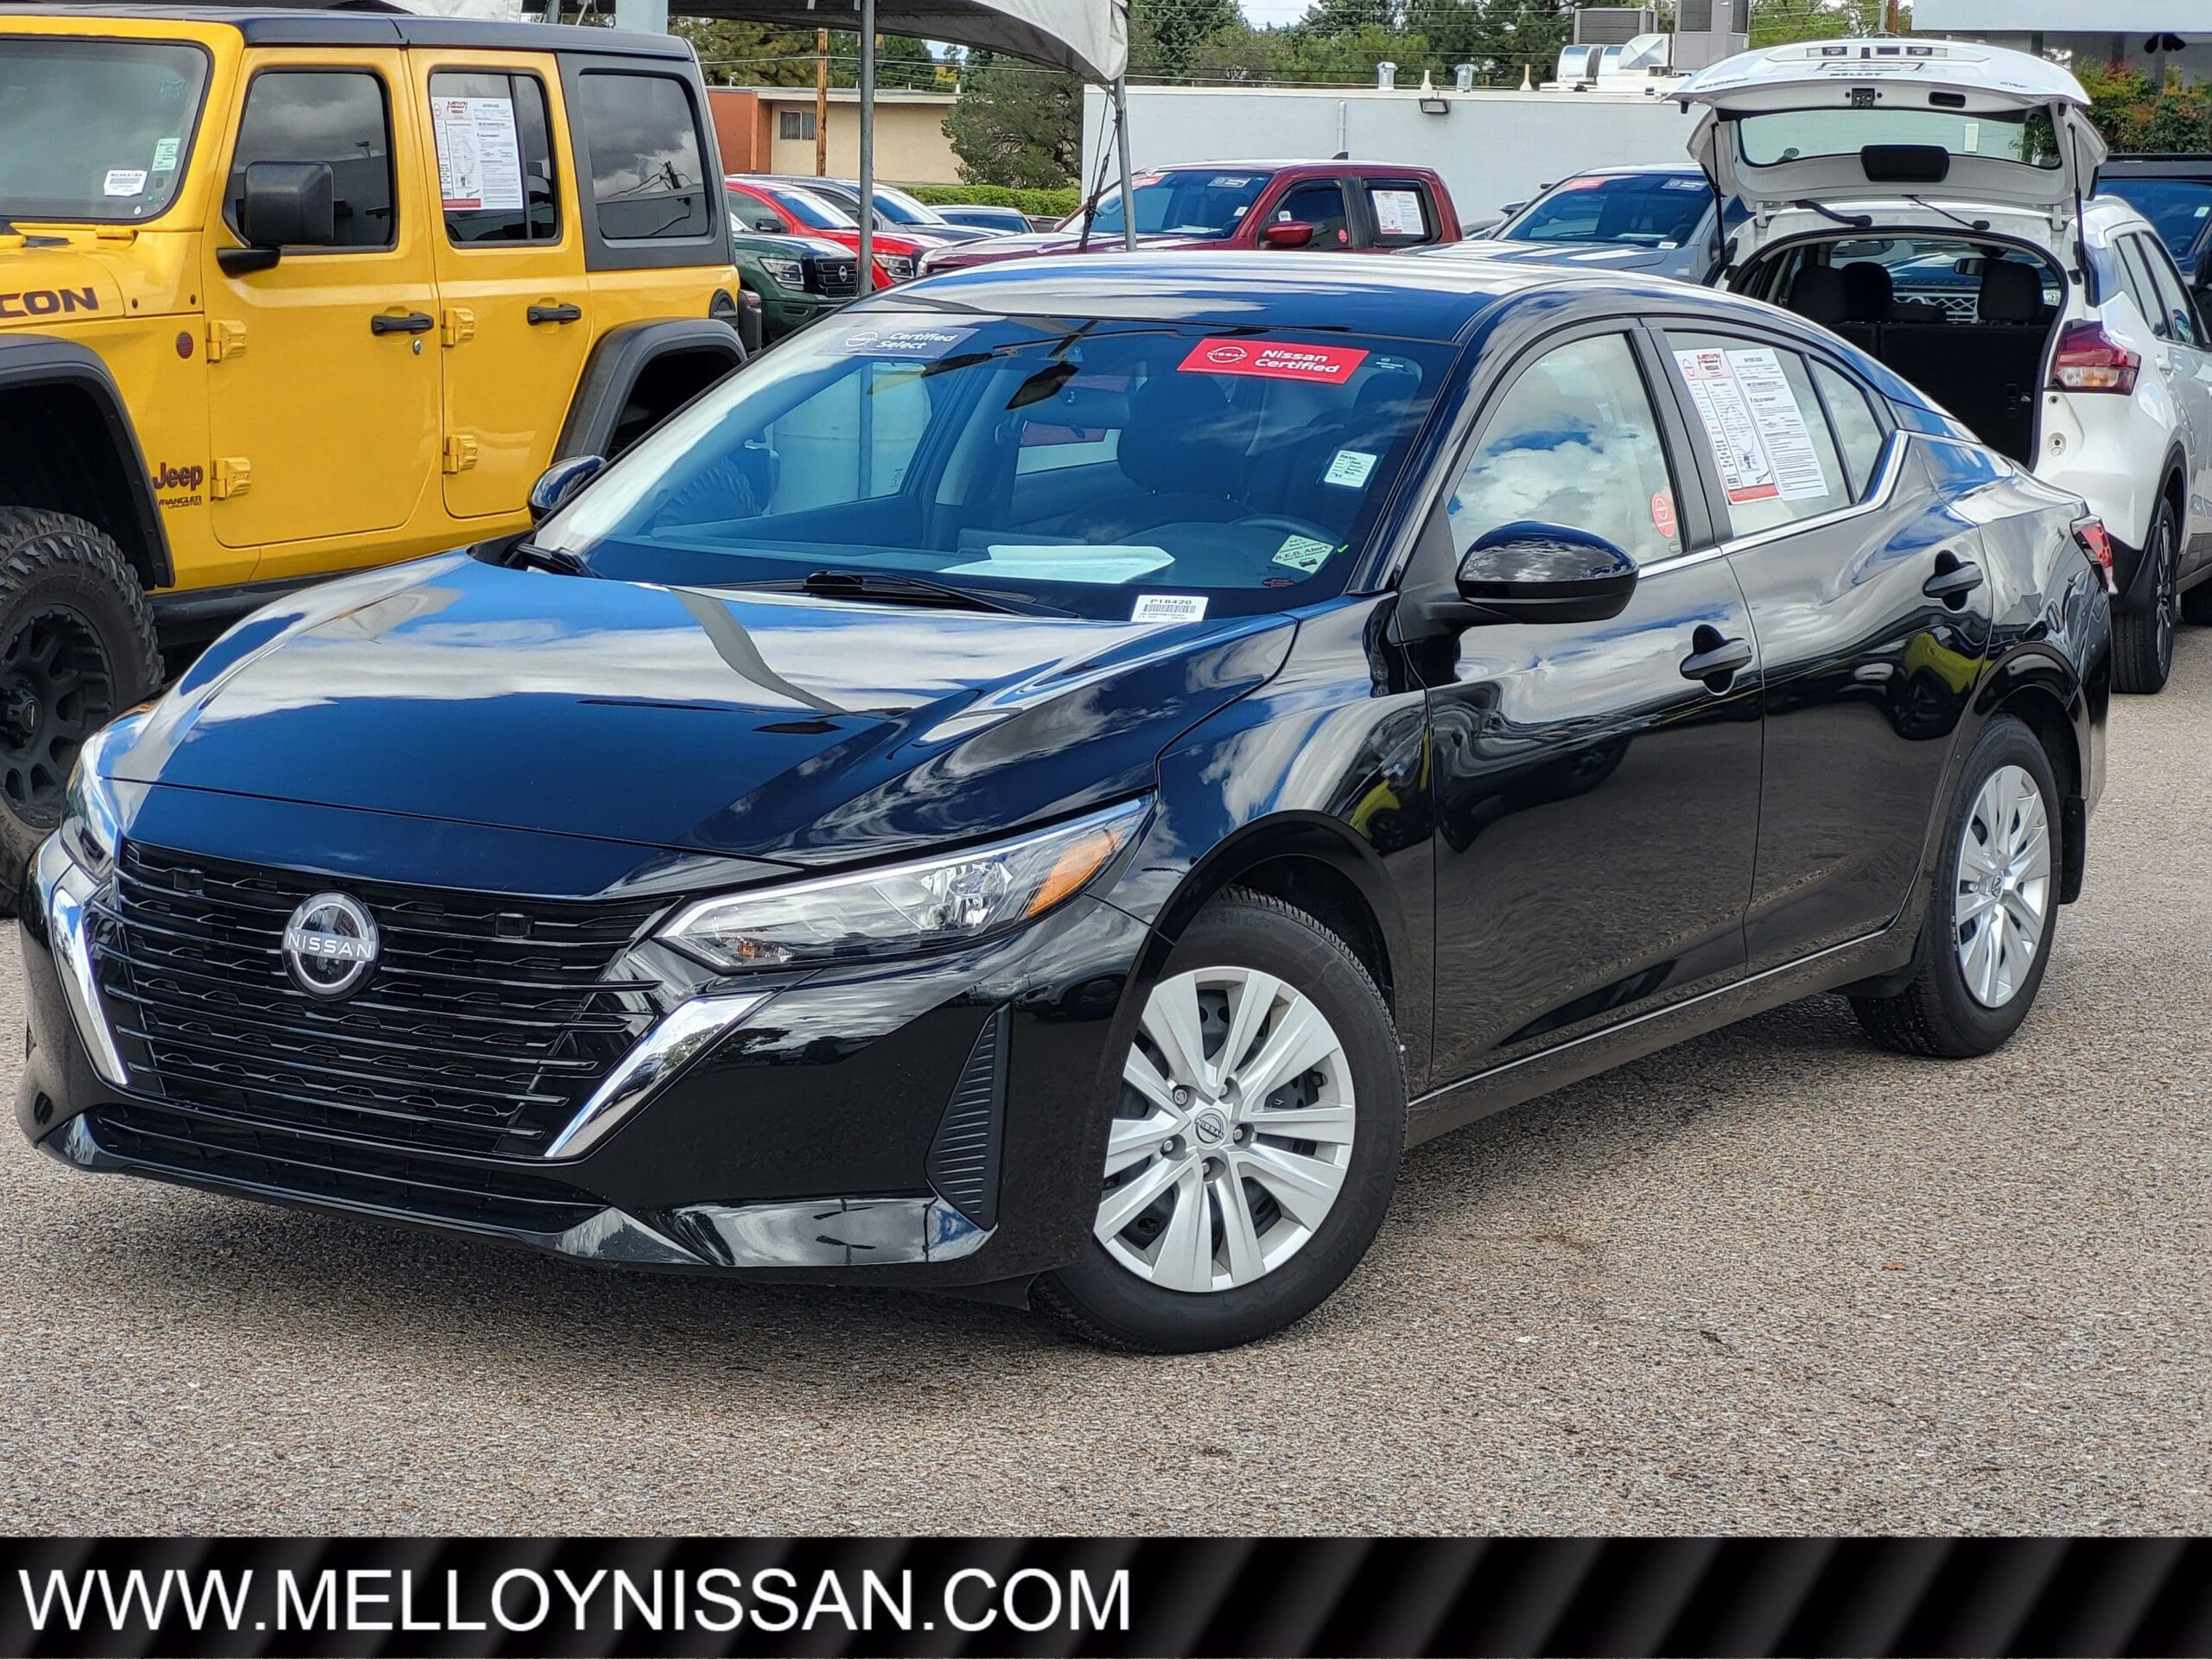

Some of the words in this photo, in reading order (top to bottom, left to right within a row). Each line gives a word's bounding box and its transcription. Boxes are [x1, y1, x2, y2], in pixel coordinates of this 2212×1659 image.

[890, 332, 958, 342] Certified
[876, 340, 927, 349] Select
[1262, 349, 1329, 363] Nissan
[1255, 359, 1341, 373] Certified
[152, 461, 204, 492] Jeep
[288, 932, 372, 958] NISSAN
[1195, 1118, 1224, 1140] NISSAN
